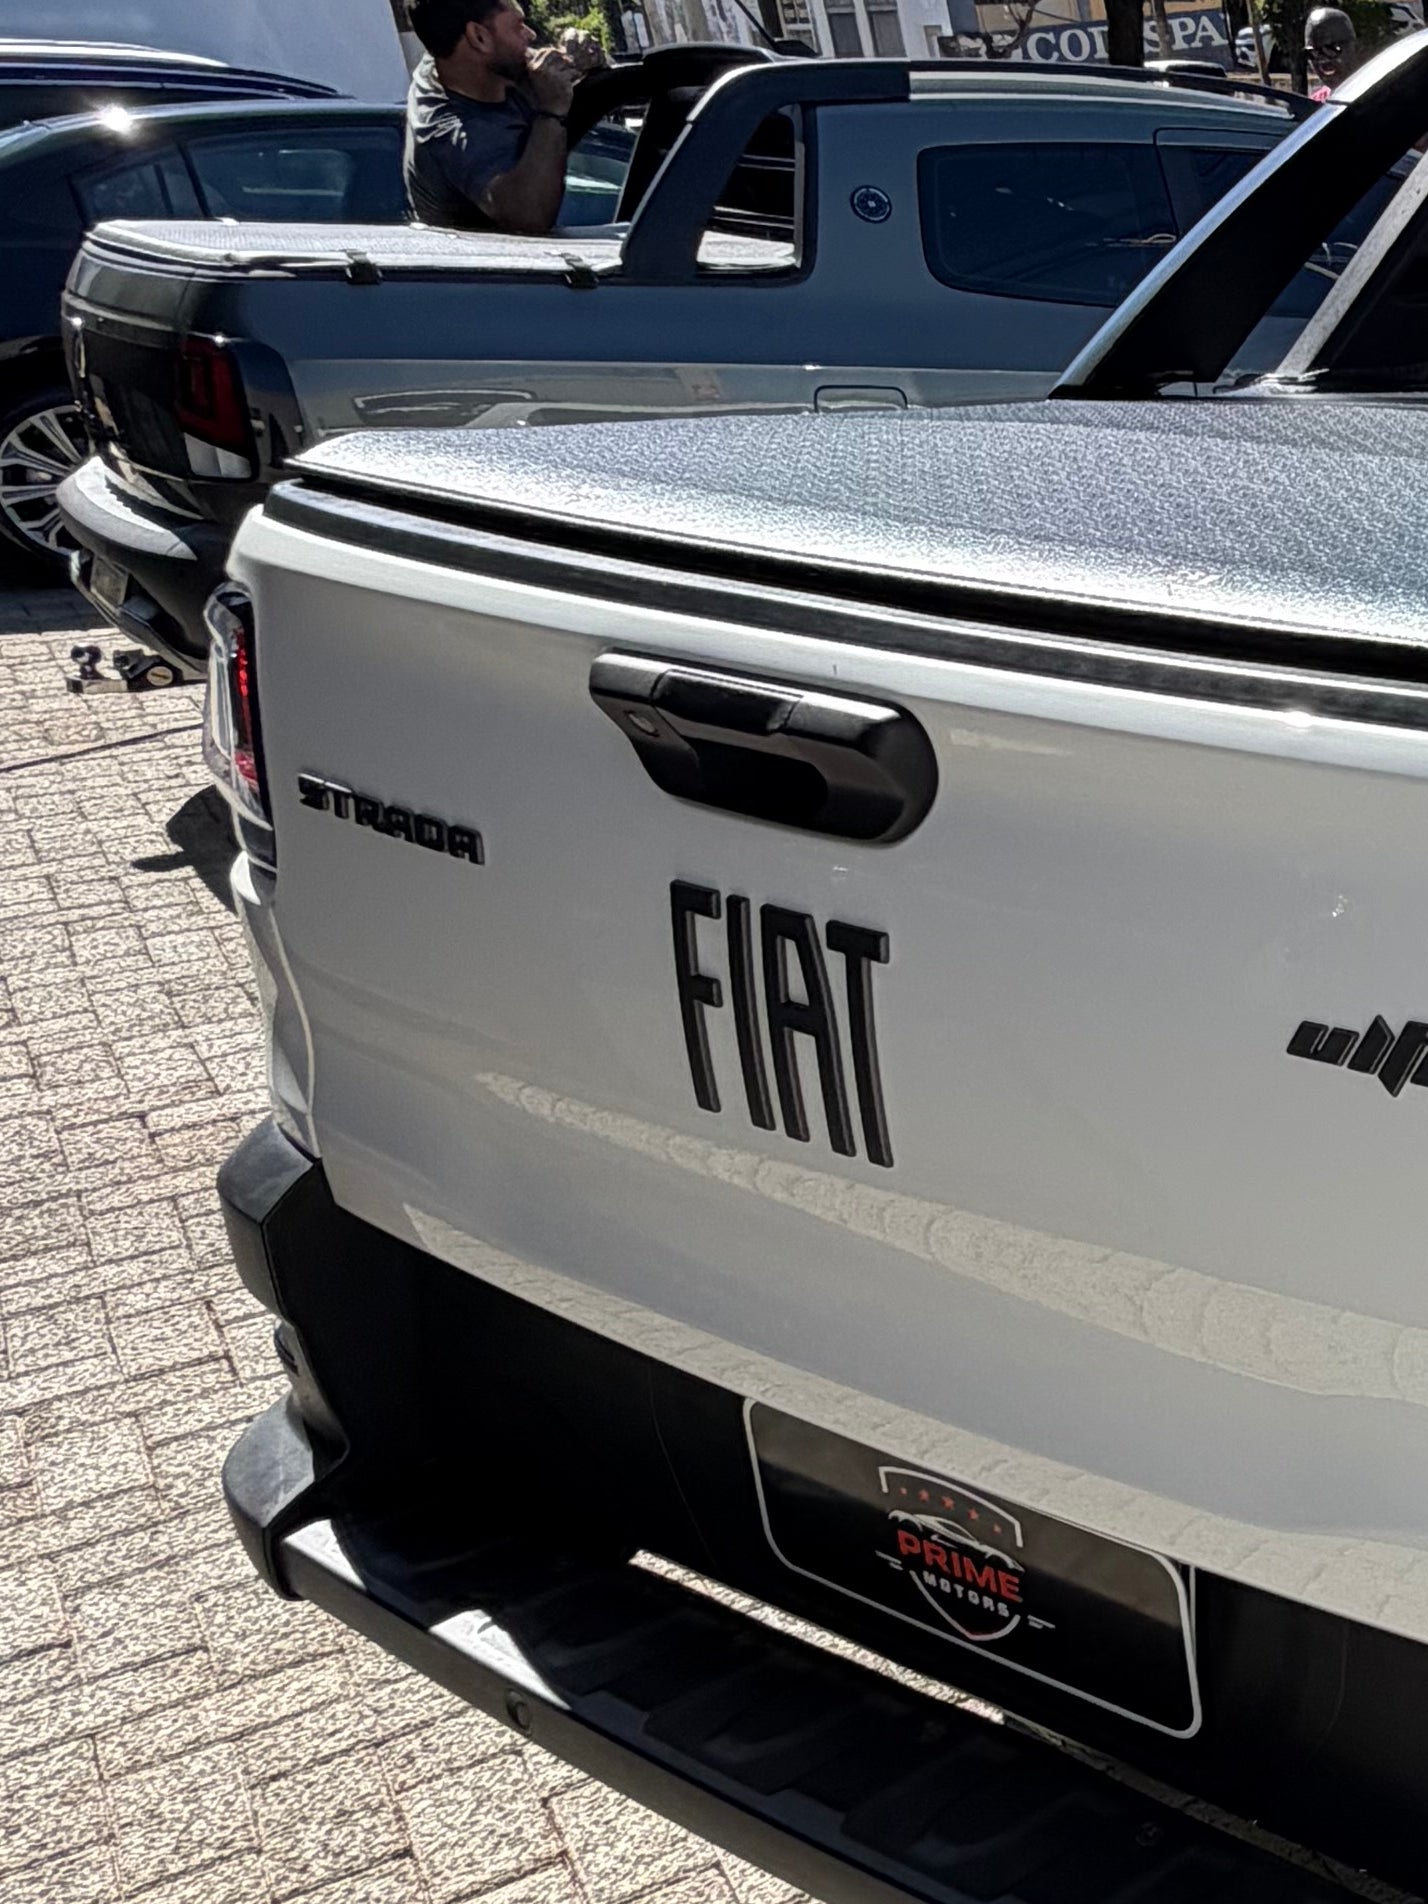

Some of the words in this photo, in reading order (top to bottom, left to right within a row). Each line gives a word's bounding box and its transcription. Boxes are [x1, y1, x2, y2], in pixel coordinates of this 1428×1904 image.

[298, 770, 486, 866] STRADA
[670, 879, 894, 1168] FIAT
[897, 1529, 1024, 1603] PRIME
[922, 1570, 1010, 1617] MOTORS
